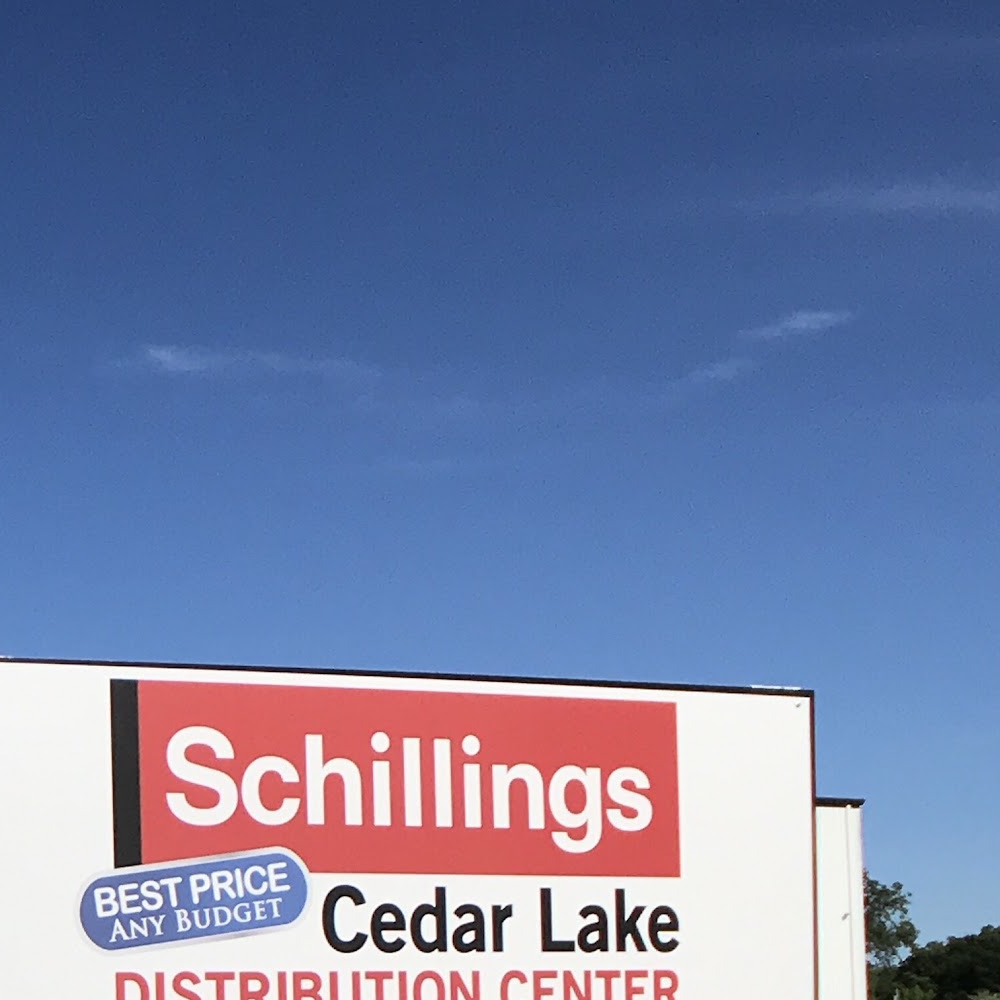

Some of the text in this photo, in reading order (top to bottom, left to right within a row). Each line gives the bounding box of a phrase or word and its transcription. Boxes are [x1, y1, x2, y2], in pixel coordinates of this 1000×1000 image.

[165, 725, 653, 854] Schillings
[93, 861, 291, 918] BEST PRICE
[108, 897, 283, 943] ANY BUDGET
[321, 884, 680, 954] Cedar Lake
